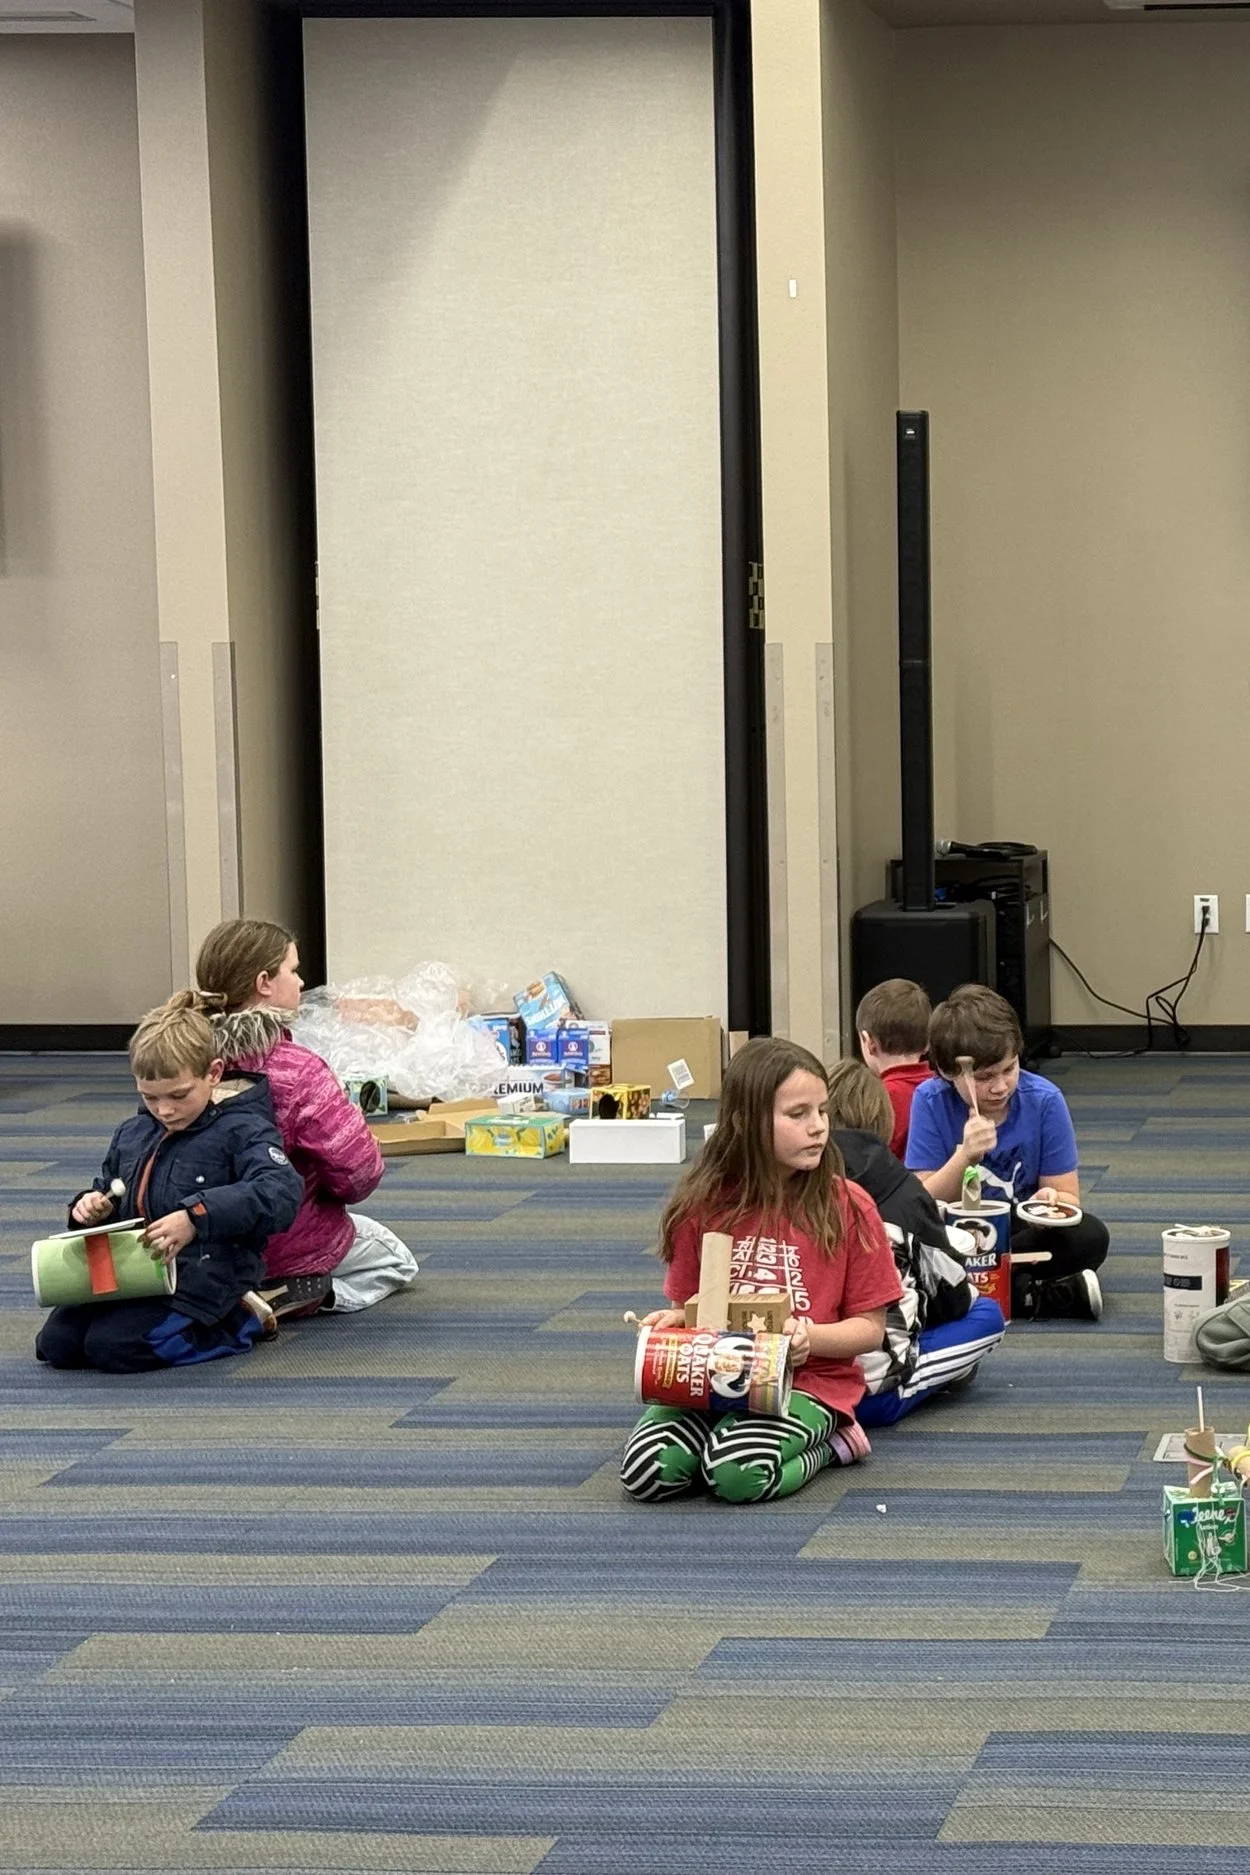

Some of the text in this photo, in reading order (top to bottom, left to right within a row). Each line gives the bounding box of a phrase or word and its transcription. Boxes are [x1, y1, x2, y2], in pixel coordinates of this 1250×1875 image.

[494, 1082, 544, 1095] EMIUM
[965, 1253, 998, 1267] AKER
[967, 1272, 989, 1284] ATS
[676, 1342, 694, 1384] OATS
[690, 1333, 714, 1397] QUAKER
